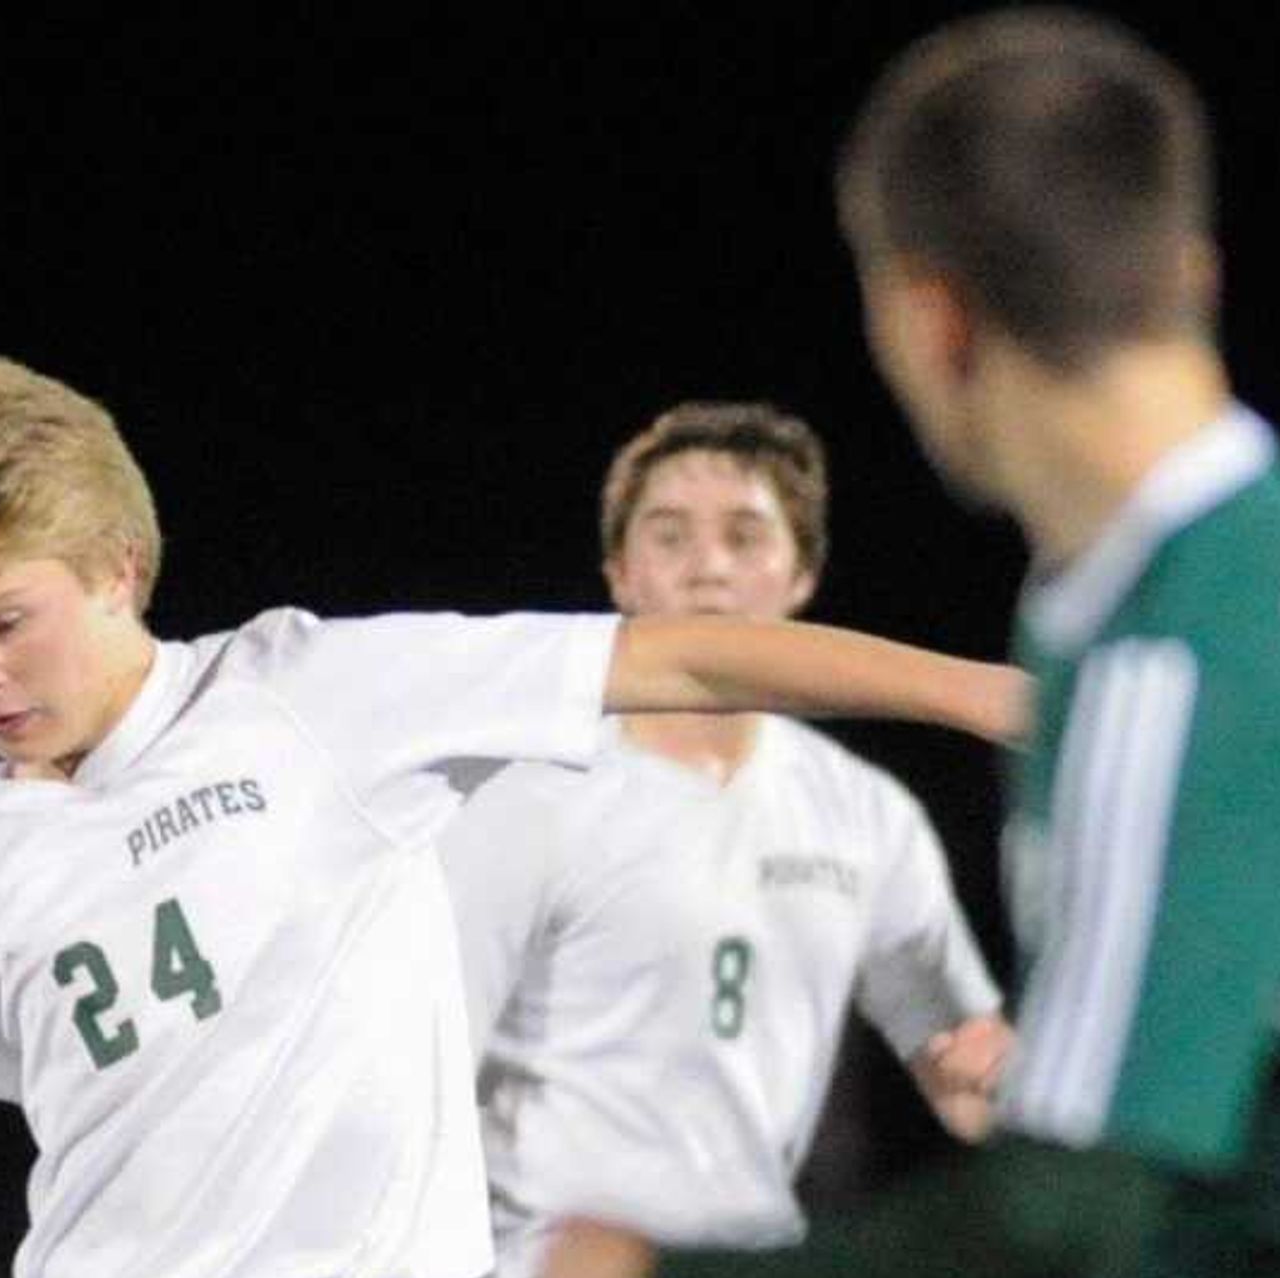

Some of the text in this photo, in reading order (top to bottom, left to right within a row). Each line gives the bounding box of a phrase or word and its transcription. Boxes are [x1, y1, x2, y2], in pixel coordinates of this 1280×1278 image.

[125, 779, 267, 867] PIRATES
[53, 897, 223, 1070] 24
[711, 936, 751, 1041] 8
